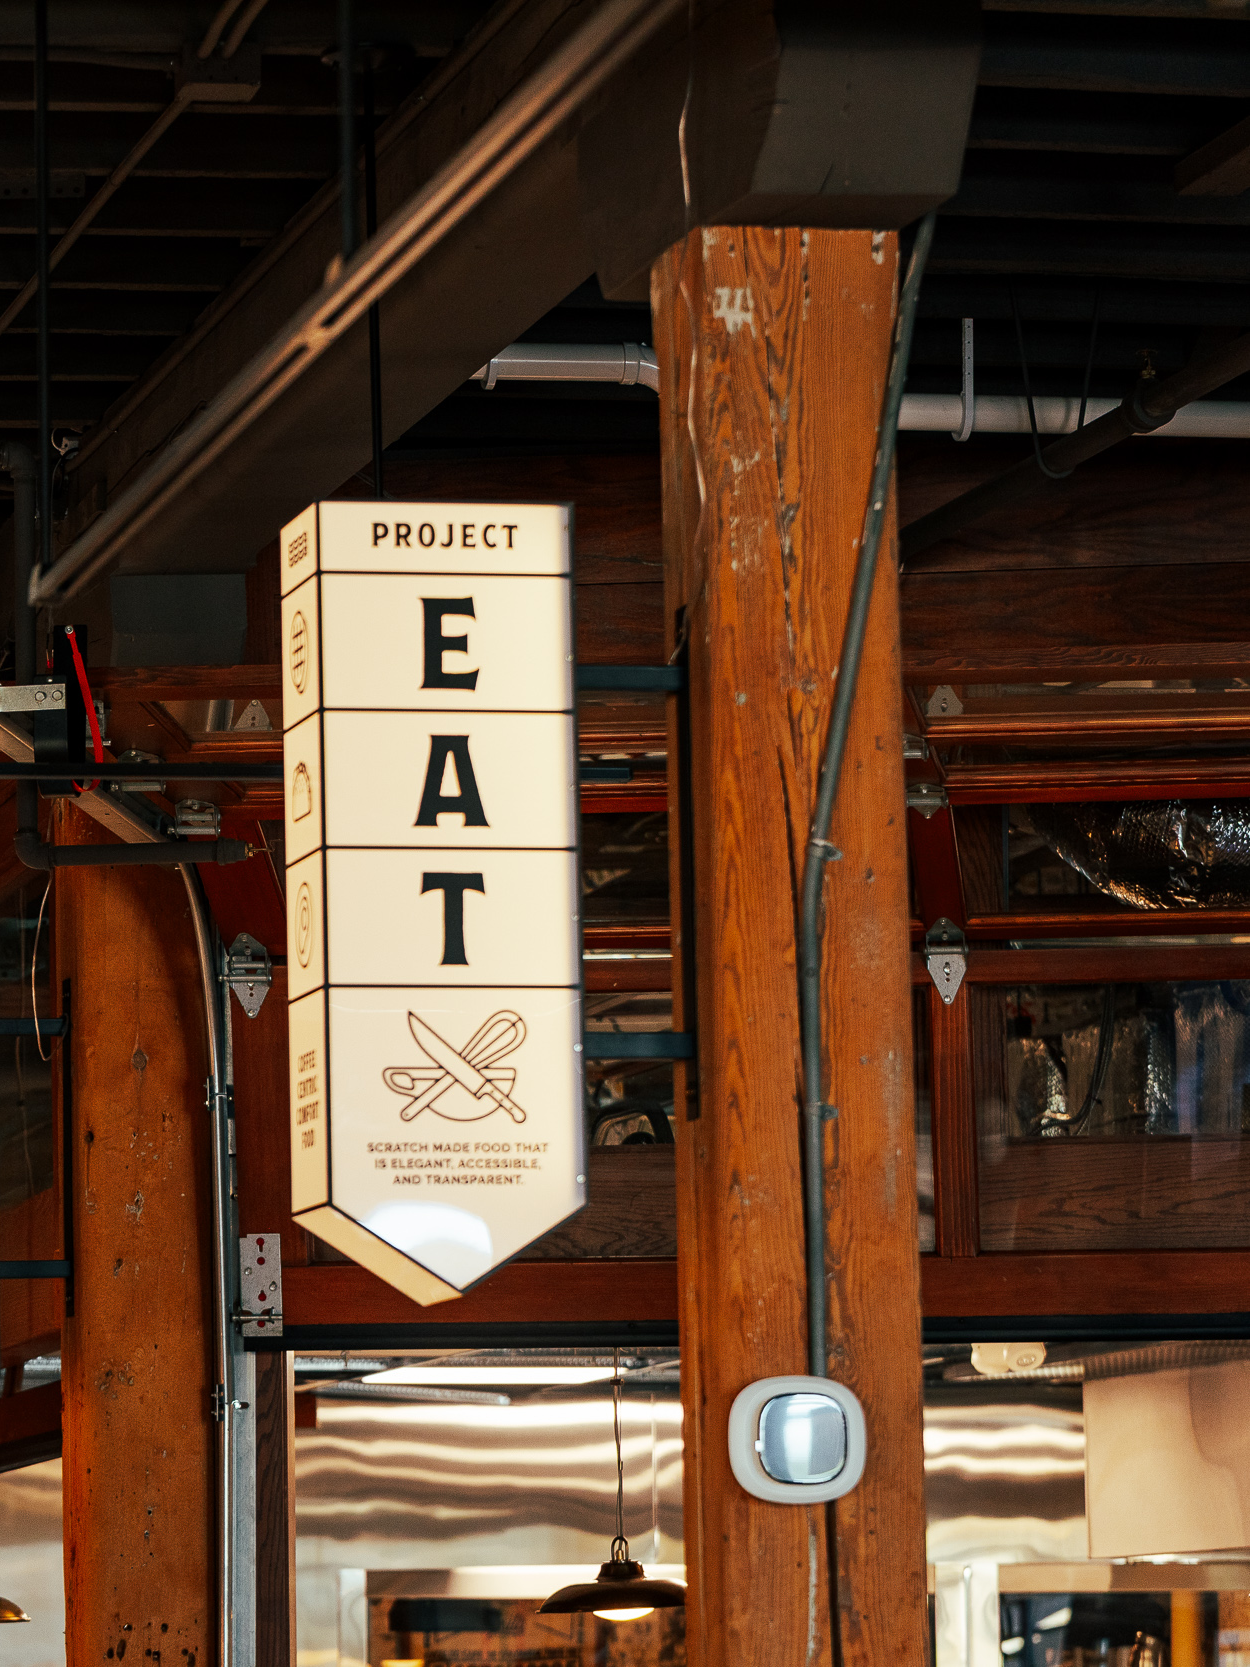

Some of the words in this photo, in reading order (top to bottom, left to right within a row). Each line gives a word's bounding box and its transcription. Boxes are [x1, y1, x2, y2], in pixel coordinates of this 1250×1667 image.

[371, 521, 519, 550] PROJECT
[413, 595, 490, 967] EAT
[297, 1048, 316, 1074] COFFEE
[297, 1075, 319, 1101] CENTRIC
[296, 1100, 319, 1127] COMFORT
[301, 1127, 315, 1150] FOOD
[366, 1141, 429, 1154] SCRATCH
[432, 1141, 470, 1154] MADE
[473, 1141, 511, 1154] FOOD
[514, 1141, 549, 1154] THAT
[374, 1157, 388, 1170] IS
[390, 1157, 454, 1170] ELEGANT,
[457, 1157, 541, 1170] ACCESSIBLE,
[392, 1173, 422, 1186] AND
[425, 1173, 524, 1186] TRANSPARENT.
